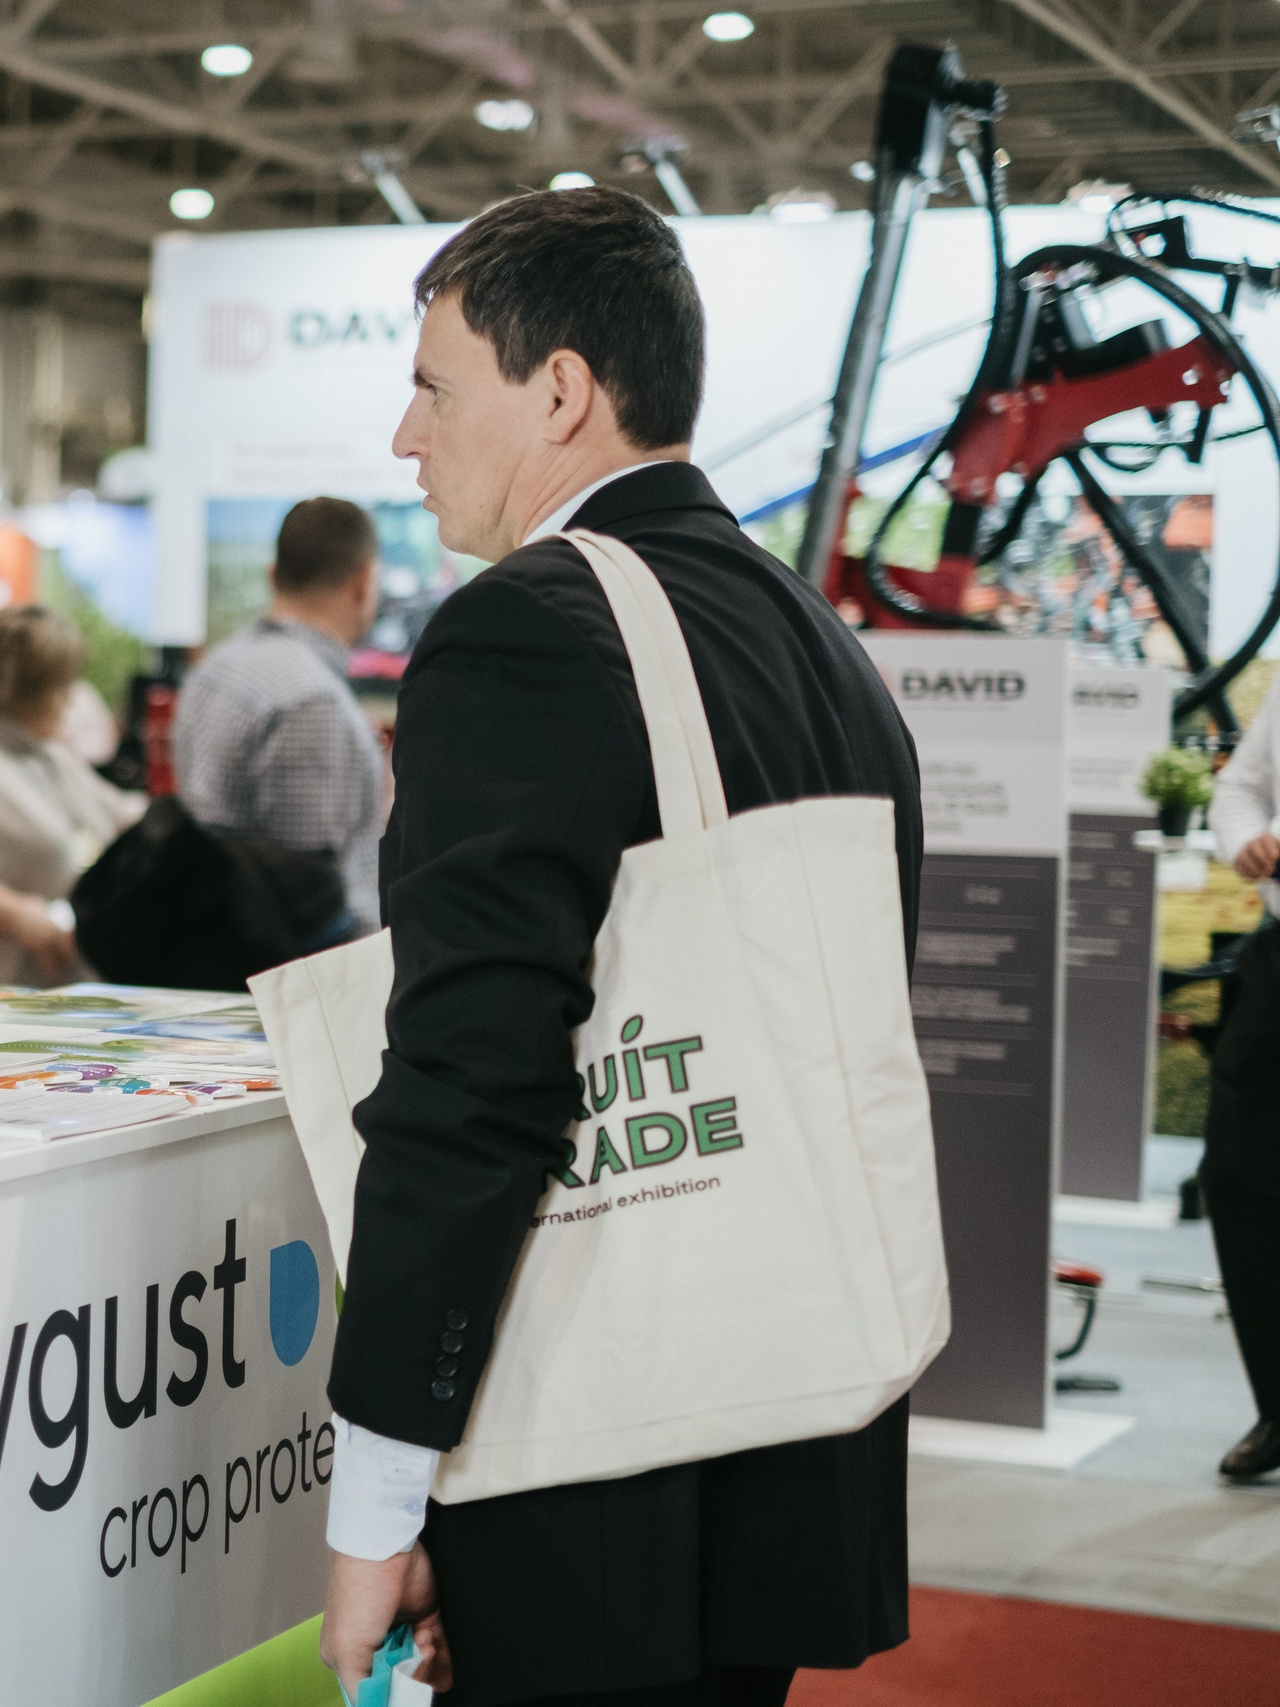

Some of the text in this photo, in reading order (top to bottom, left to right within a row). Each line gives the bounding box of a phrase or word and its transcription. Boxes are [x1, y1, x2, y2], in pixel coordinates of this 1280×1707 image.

[902, 668, 1026, 701] DAVID
[617, 1176, 721, 1208] exhibition
[99, 1411, 336, 1578] crop prote
